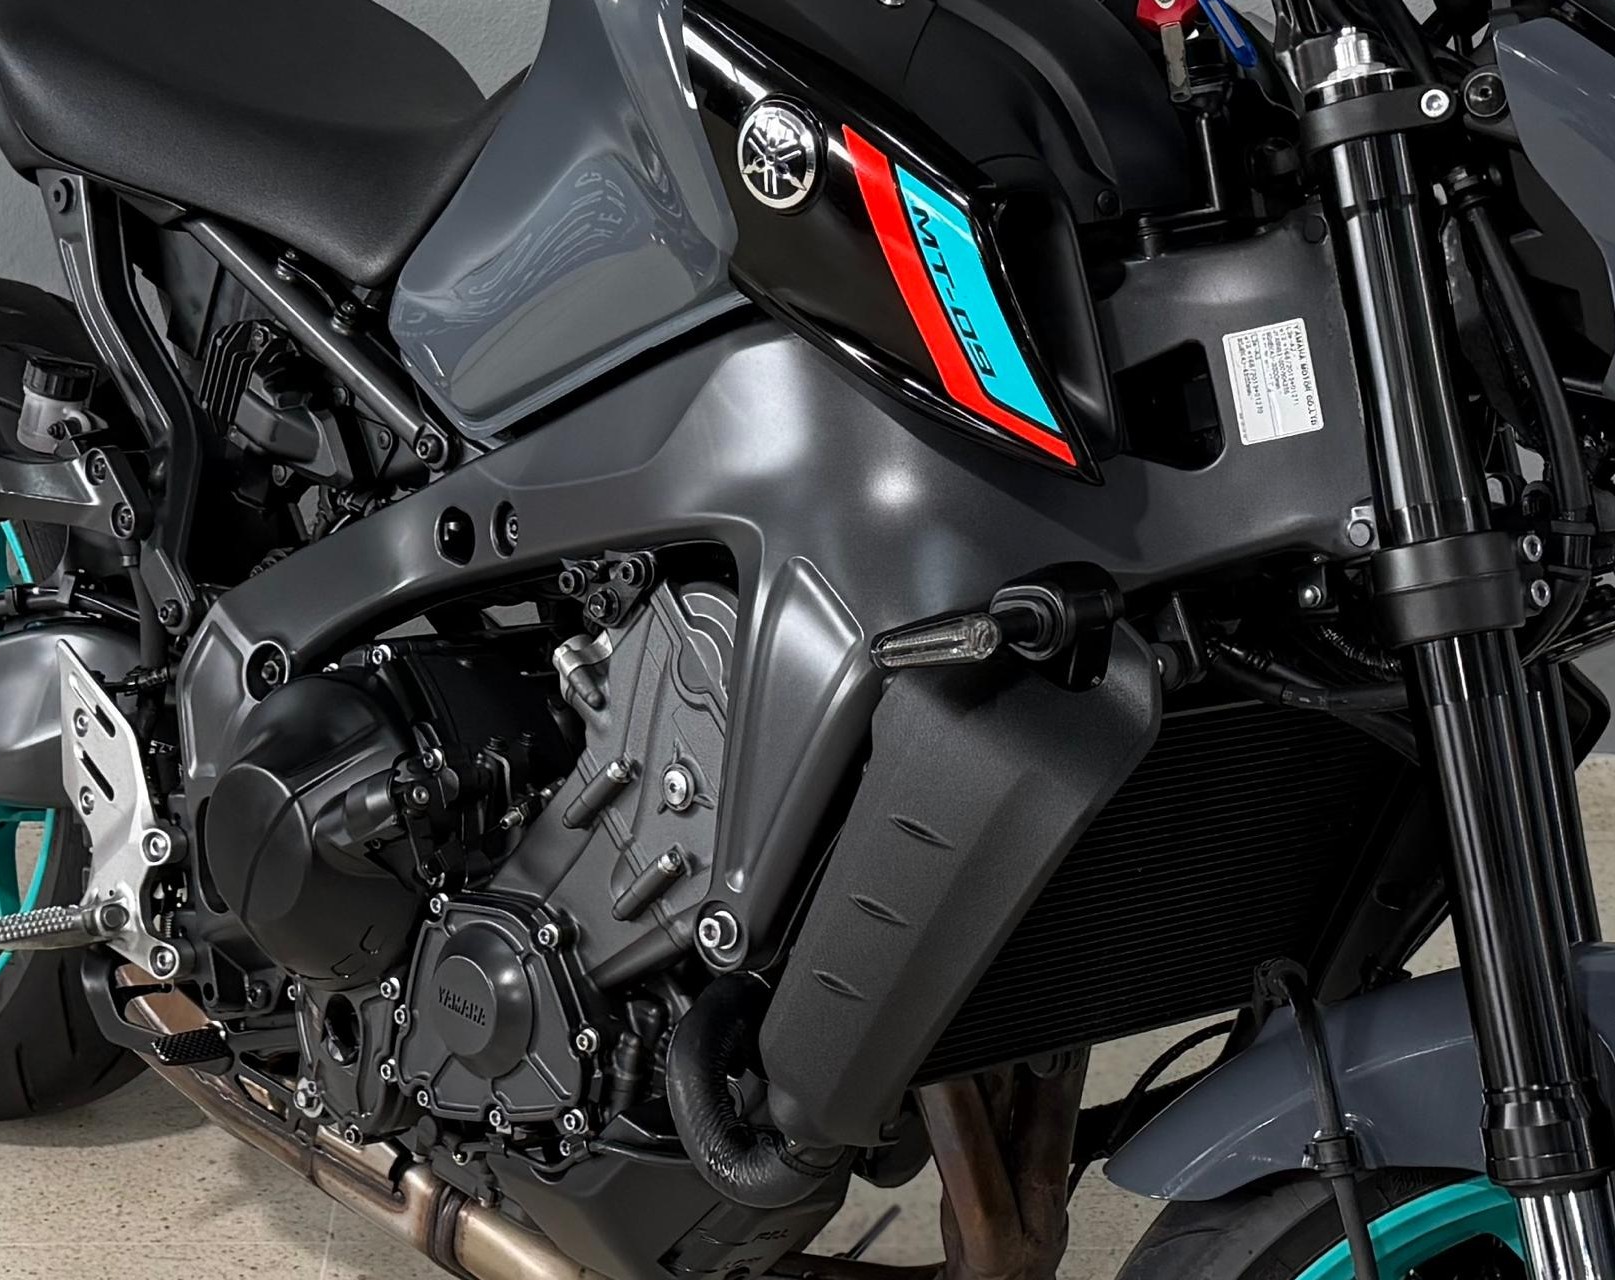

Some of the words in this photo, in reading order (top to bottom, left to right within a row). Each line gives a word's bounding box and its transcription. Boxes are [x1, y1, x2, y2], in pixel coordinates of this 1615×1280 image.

[911, 205, 998, 379] MT-09
[1293, 324, 1305, 360] YAMAHA
[439, 984, 486, 1027] YAMAHA
